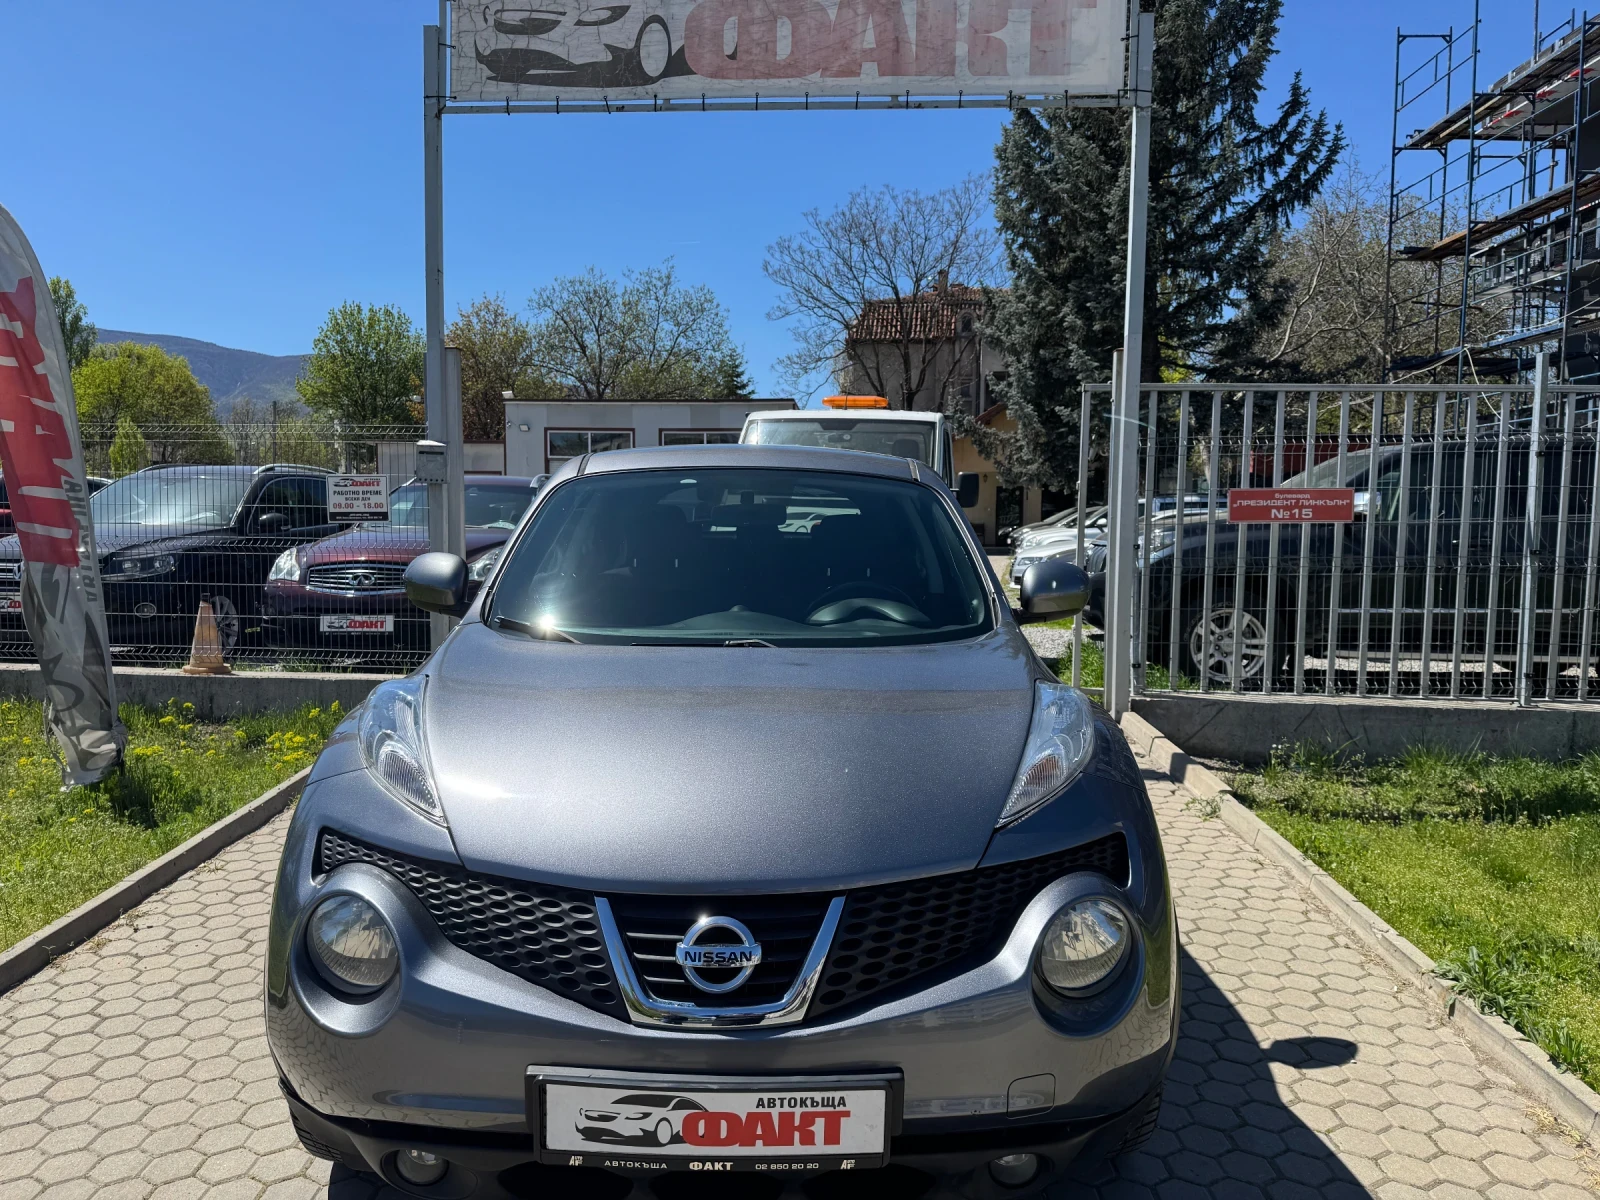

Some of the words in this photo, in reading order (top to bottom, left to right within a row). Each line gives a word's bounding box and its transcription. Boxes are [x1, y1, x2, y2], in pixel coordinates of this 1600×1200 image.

[684, 0, 1097, 79] ФАКТ
[684, 950, 752, 963] NISSAN
[756, 1096, 847, 1110] АВТОКЪЩА
[682, 1110, 851, 1147] ФАКТ
[689, 1161, 734, 1171] ФАКТ
